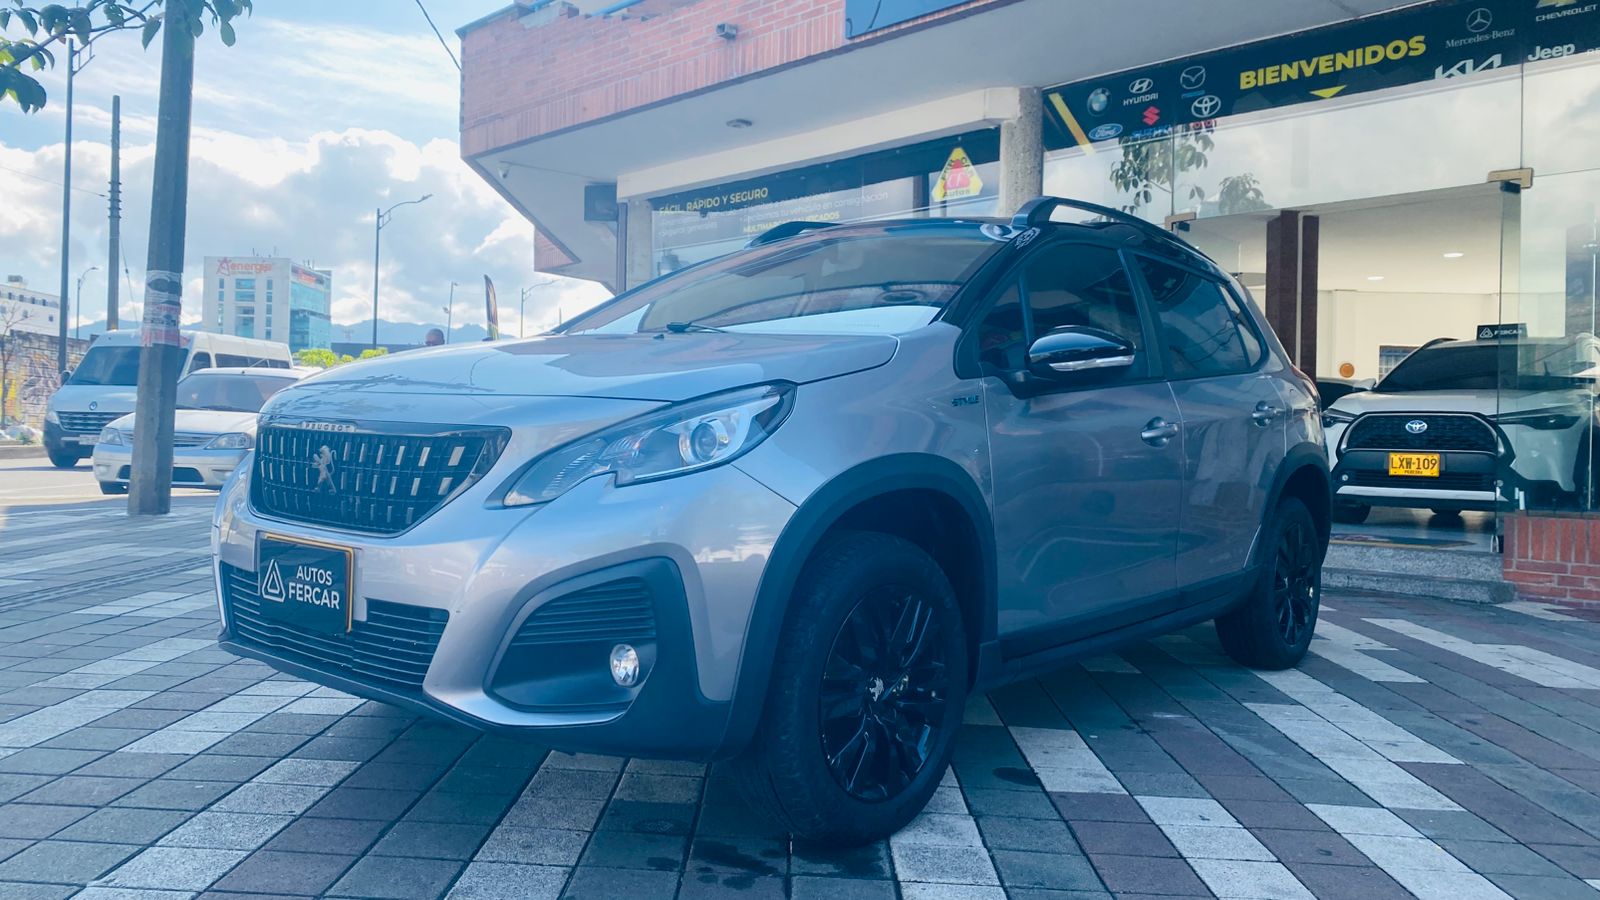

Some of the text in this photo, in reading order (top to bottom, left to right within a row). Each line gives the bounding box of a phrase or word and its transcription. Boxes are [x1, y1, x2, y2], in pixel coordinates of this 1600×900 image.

[1535, 4, 1598, 22] CHEVROLET
[1445, 28, 1516, 48] Mercedes-Benz
[1527, 43, 1576, 61] Jeep
[1240, 35, 1427, 90] BIENVENIDOS
[1123, 92, 1159, 106] HYUNDAI
[686, 196, 721, 212] RÁPIDO
[722, 194, 729, 205] Y
[729, 187, 769, 204] SEGURO
[305, 423, 352, 432] PEUGEOT
[296, 565, 333, 586] AUTOS
[288, 582, 340, 610] FERCAR
